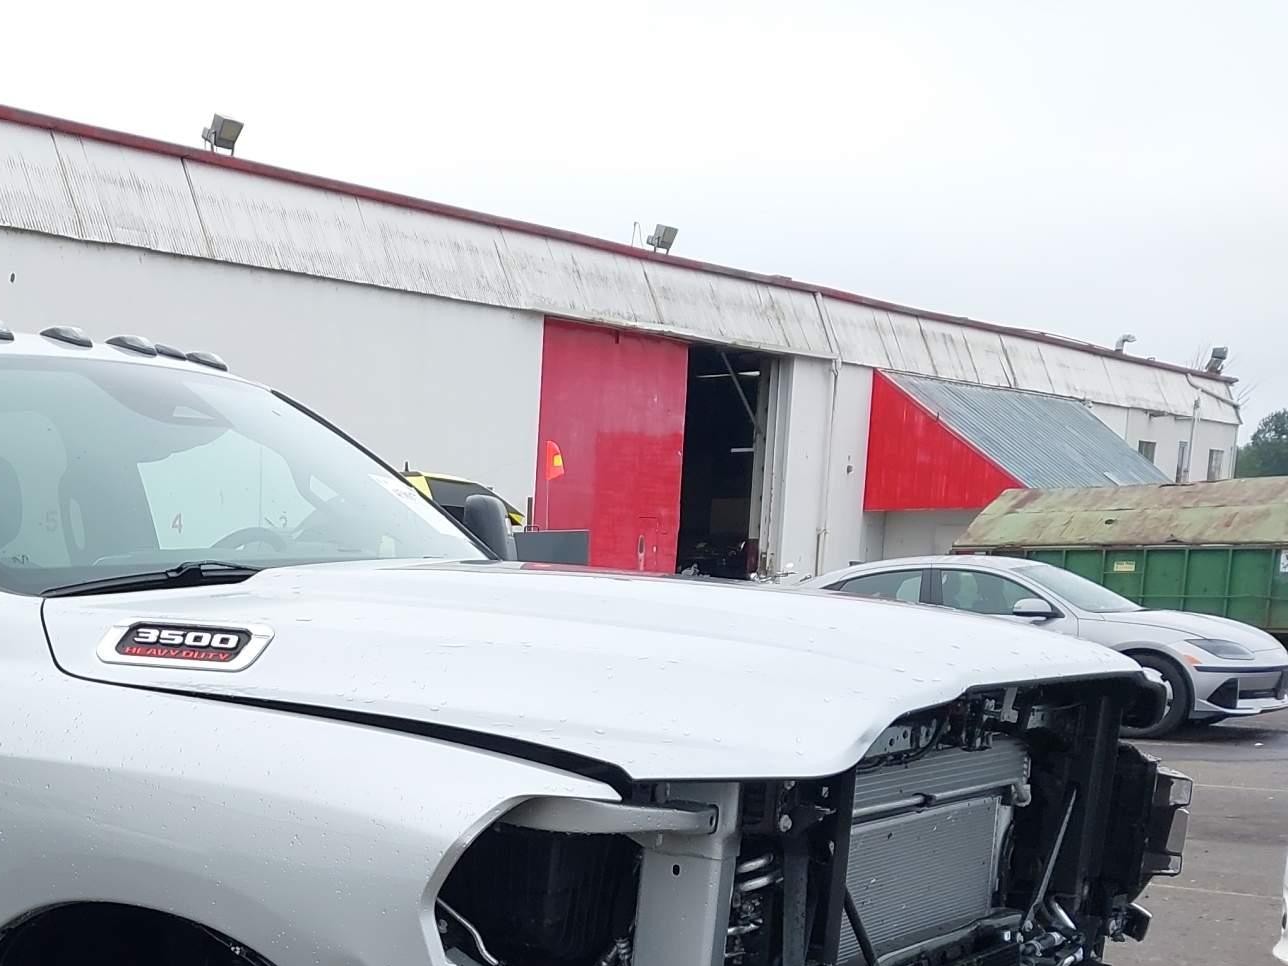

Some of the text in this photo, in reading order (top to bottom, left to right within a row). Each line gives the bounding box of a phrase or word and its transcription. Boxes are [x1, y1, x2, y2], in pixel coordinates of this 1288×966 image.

[171, 512, 183, 534] 4
[133, 628, 239, 648] 3500
[124, 646, 232, 661] HEAVY DUTY
